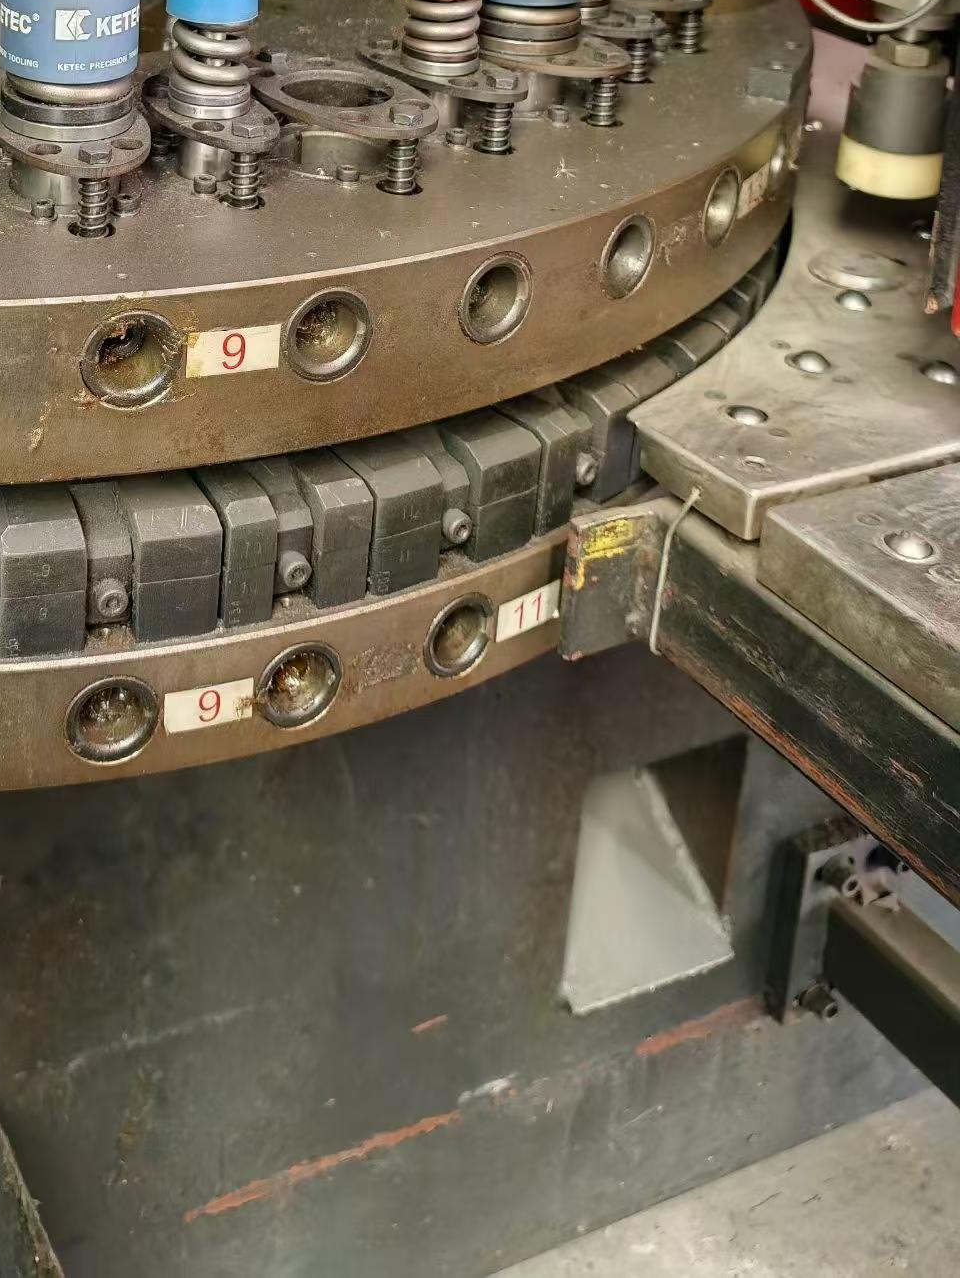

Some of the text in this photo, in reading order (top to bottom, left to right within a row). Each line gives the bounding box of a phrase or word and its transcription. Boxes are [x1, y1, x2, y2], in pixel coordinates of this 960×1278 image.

[8, 52, 39, 68] TOOLING
[57, 55, 128, 71] KETEC PRECISION
[221, 332, 247, 370] 9
[514, 593, 543, 629] 11
[198, 690, 222, 723] 9
